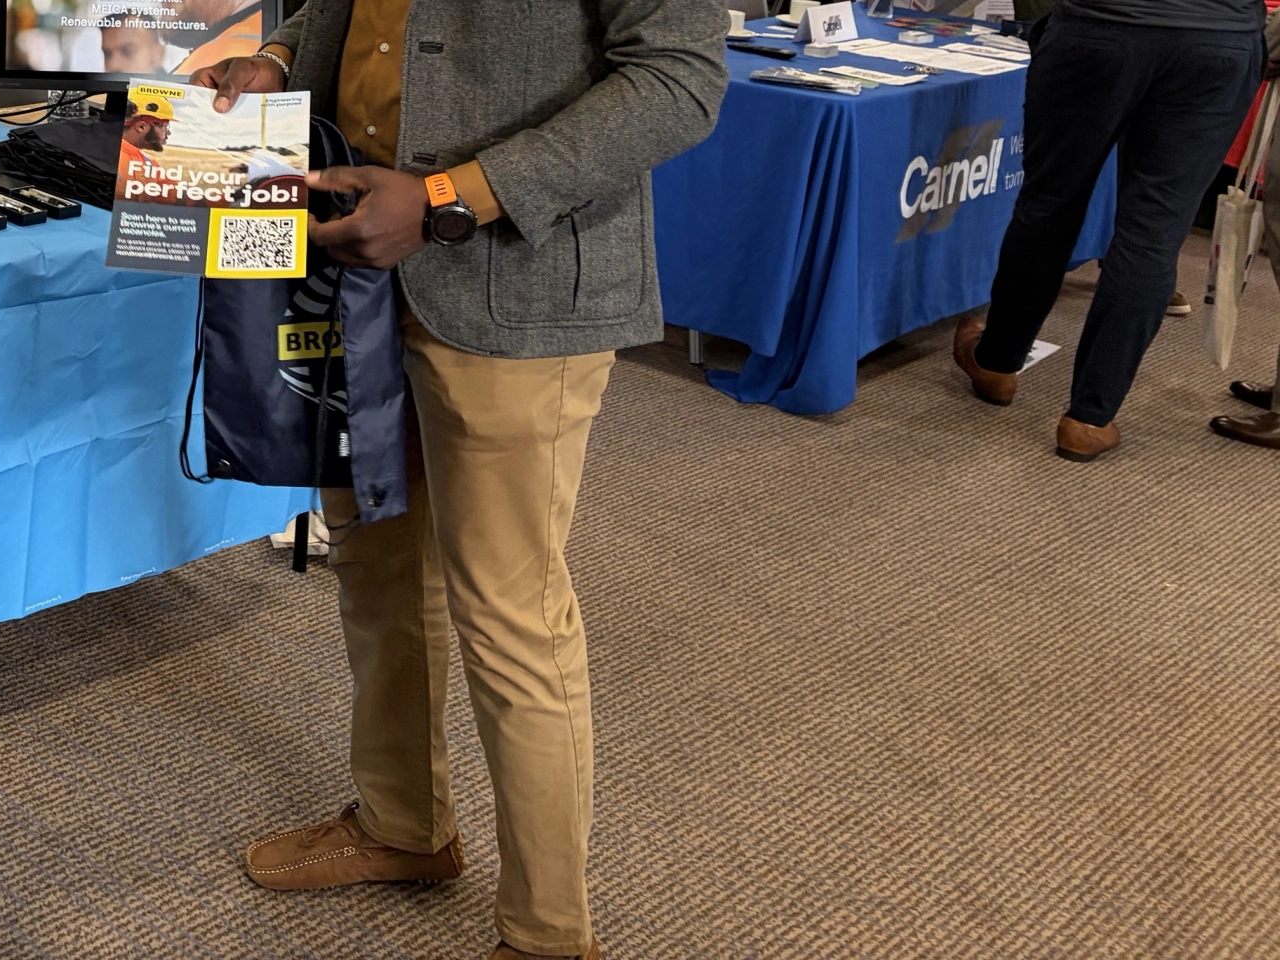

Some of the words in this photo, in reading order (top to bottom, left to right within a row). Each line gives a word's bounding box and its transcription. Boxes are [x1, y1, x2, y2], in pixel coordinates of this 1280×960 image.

[92, 4, 128, 15] MEICA
[131, 6, 178, 17] systems.
[61, 17, 122, 28] Renewable
[124, 18, 208, 31] infrastructures.
[140, 87, 183, 98] BROWNE
[128, 161, 182, 181] Find
[188, 170, 246, 186] your
[900, 138, 1004, 219] Carnell
[124, 179, 236, 202] perfect
[240, 184, 298, 207] job!
[121, 211, 144, 222] Scan
[146, 214, 166, 224] here
[168, 216, 178, 225] to
[163, 224, 197, 234] current
